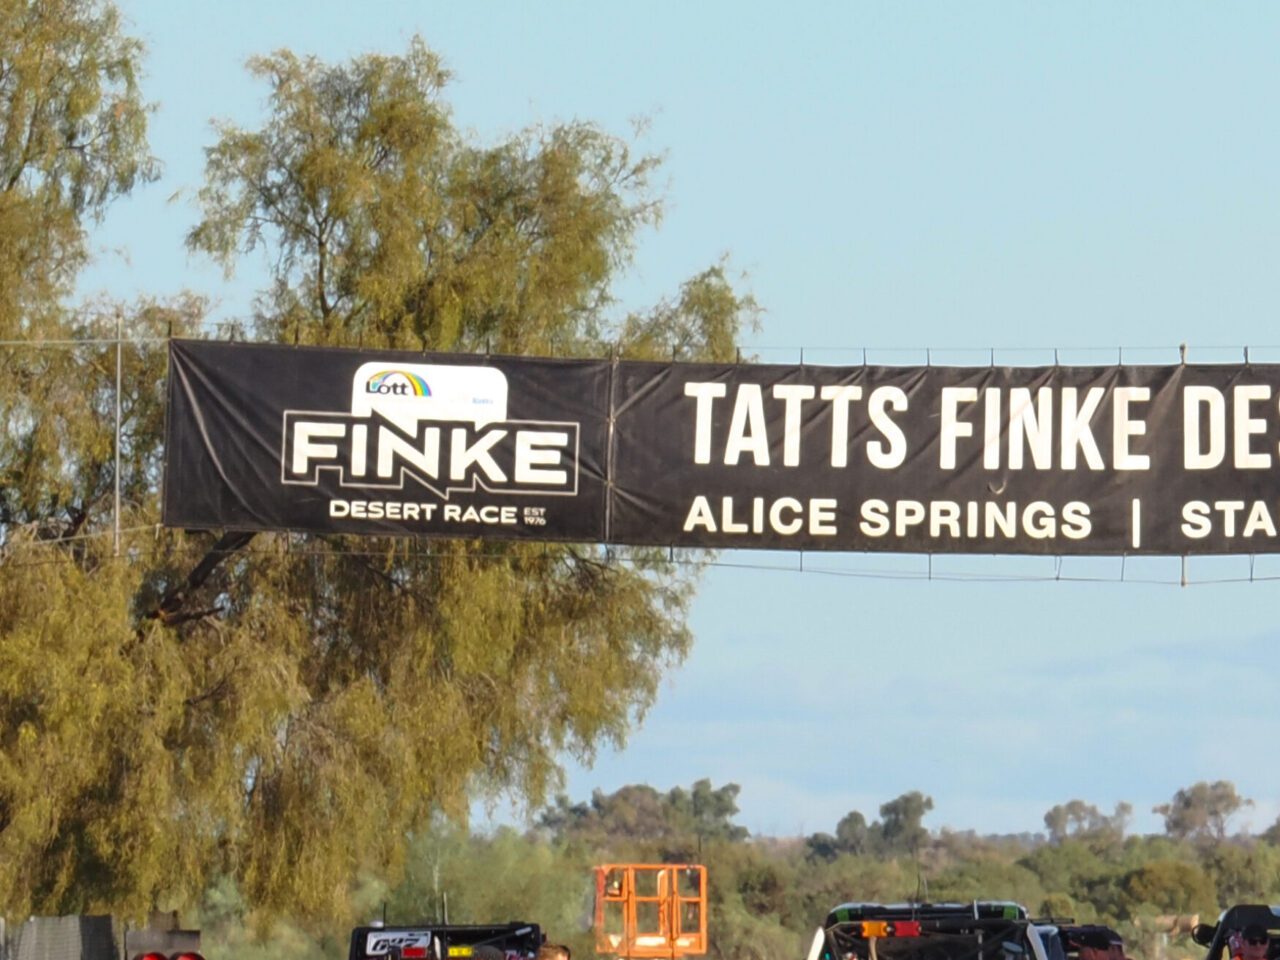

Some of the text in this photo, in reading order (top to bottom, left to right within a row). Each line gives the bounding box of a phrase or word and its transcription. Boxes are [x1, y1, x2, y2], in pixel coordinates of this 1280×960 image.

[365, 379, 409, 396] Lott
[684, 381, 908, 471] TATTS
[939, 385, 1151, 471] FINKE
[291, 420, 569, 485] FINKE
[329, 499, 518, 525] DESERT RACE
[523, 507, 546, 516] EST
[523, 516, 547, 526] 1976
[683, 495, 838, 536] ALICE
[860, 500, 1092, 540] SPRINGS
